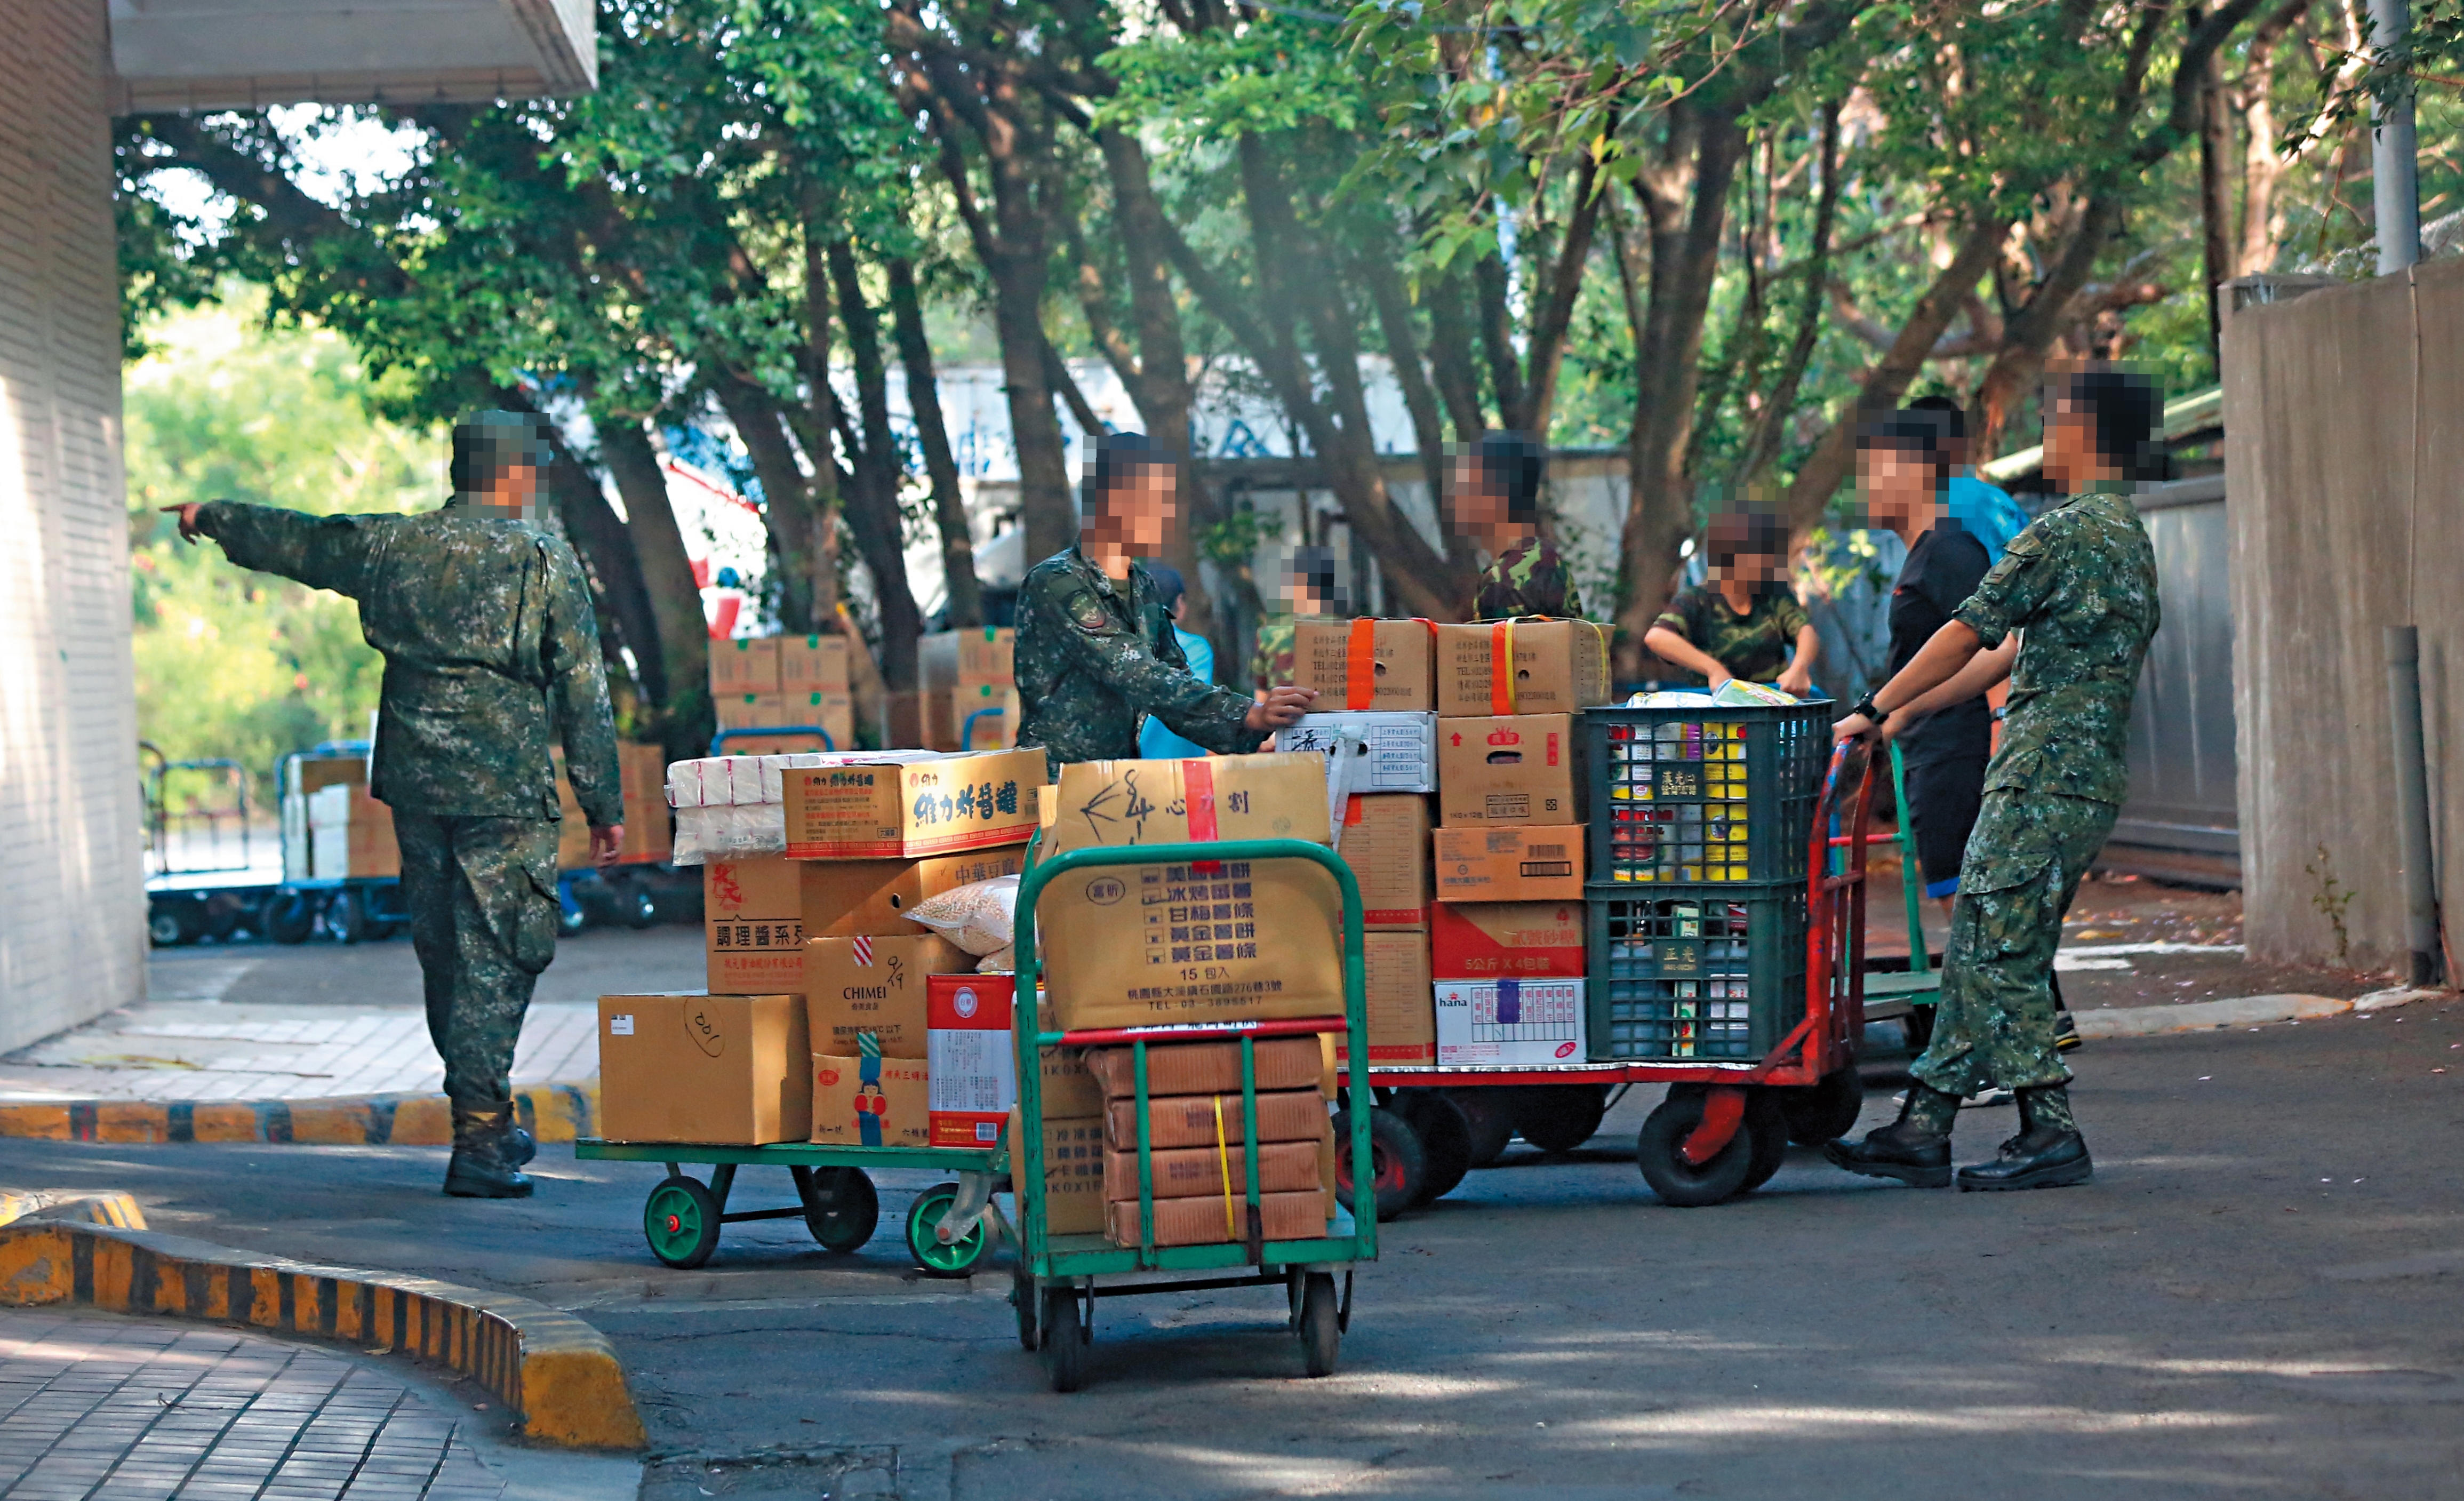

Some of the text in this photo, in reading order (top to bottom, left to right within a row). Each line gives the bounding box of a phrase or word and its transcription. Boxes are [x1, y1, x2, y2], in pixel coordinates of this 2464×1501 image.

[1170, 922, 1255, 942] 黃金薯餅
[1171, 942, 1257, 962] 黃金薯條
[1180, 968, 1198, 981] 15
[843, 987, 886, 1000] CHIMEI
[1439, 997, 1468, 1007] hana
